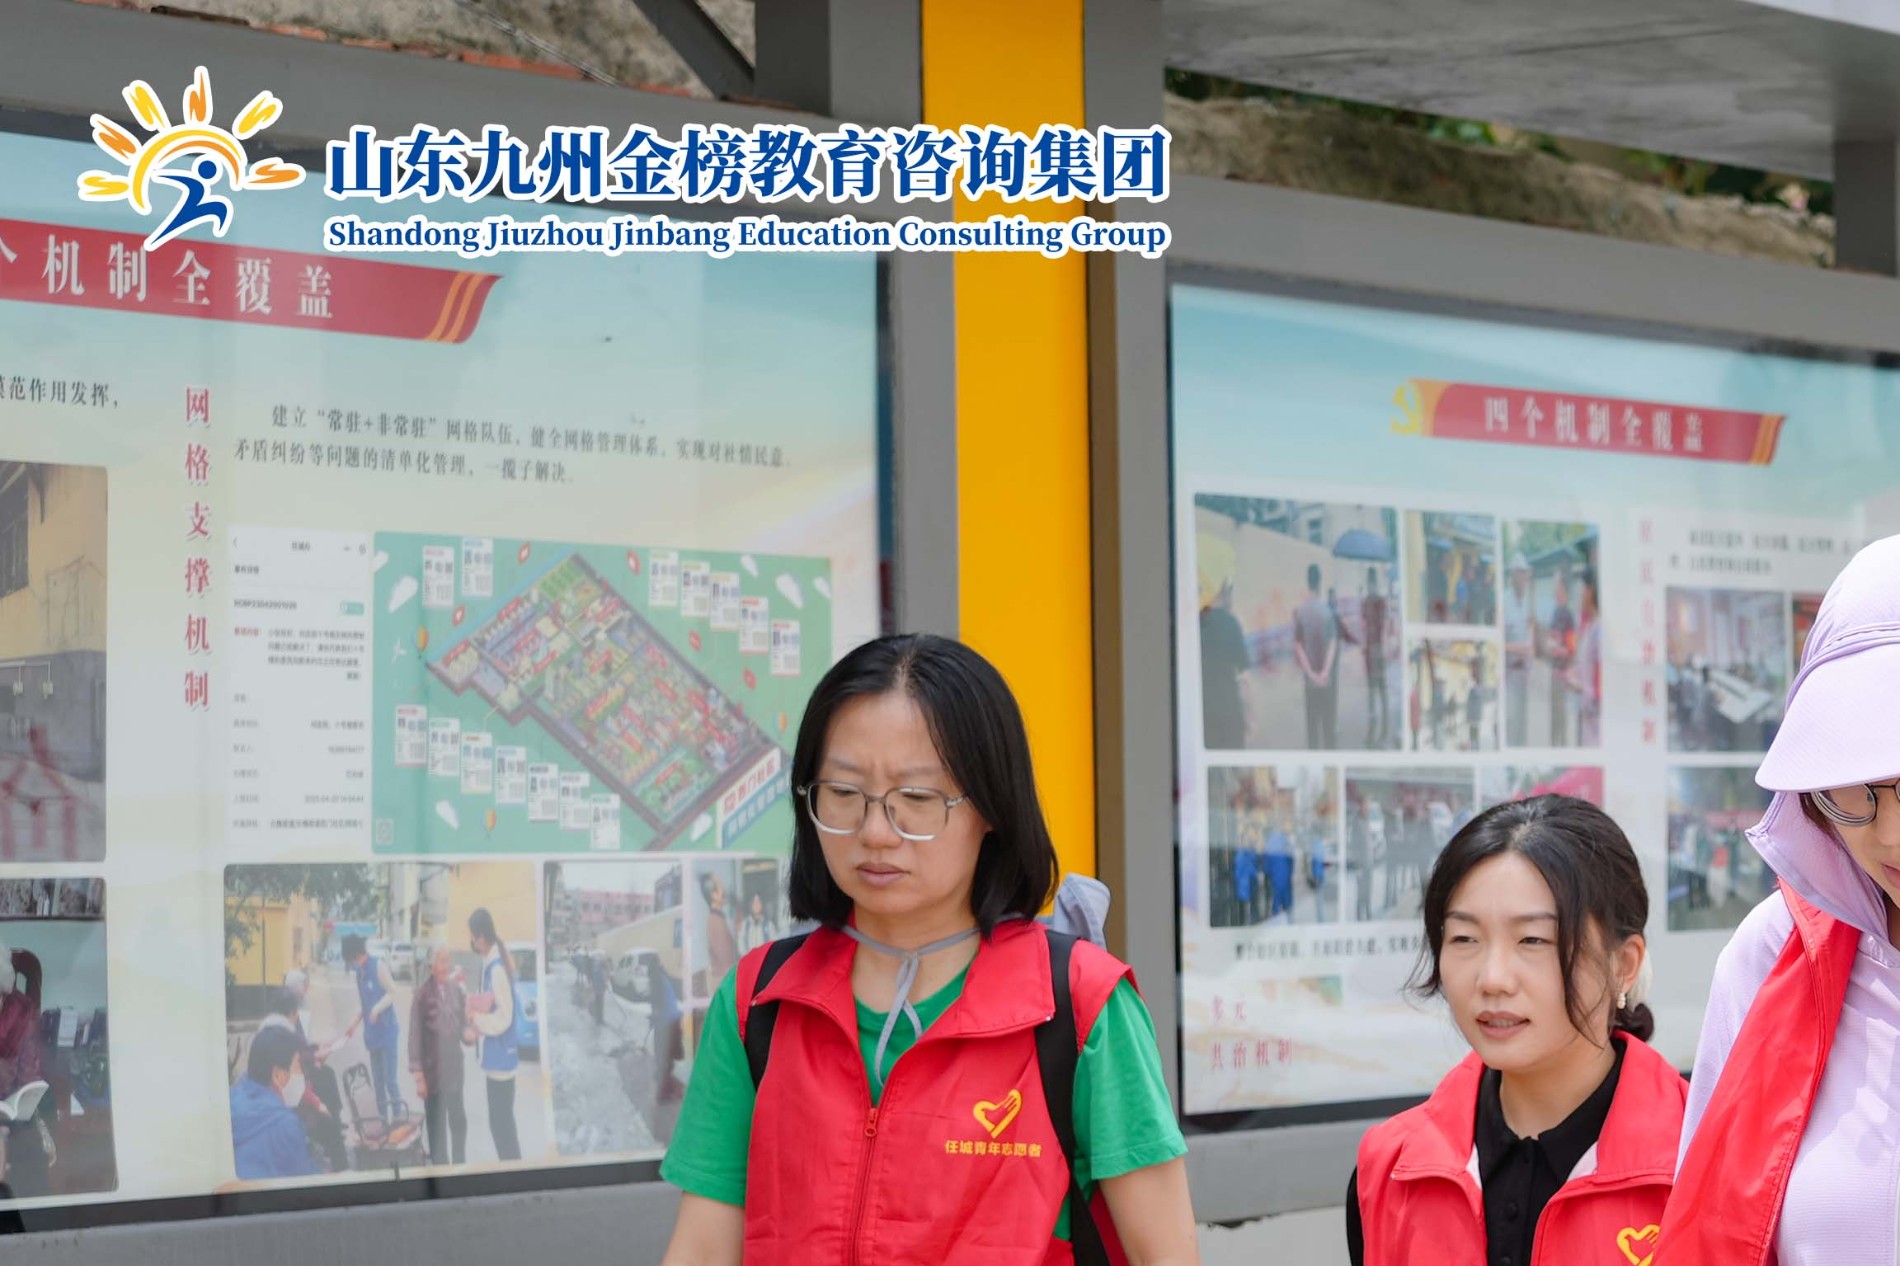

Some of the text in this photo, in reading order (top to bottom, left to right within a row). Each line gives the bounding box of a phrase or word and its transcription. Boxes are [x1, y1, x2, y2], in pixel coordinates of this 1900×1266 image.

[1484, 395, 1705, 453] 四个机制全覆盖
[185, 386, 211, 708] 网格支撑机制
[944, 1139, 1043, 1159] 任城青年志愿者
